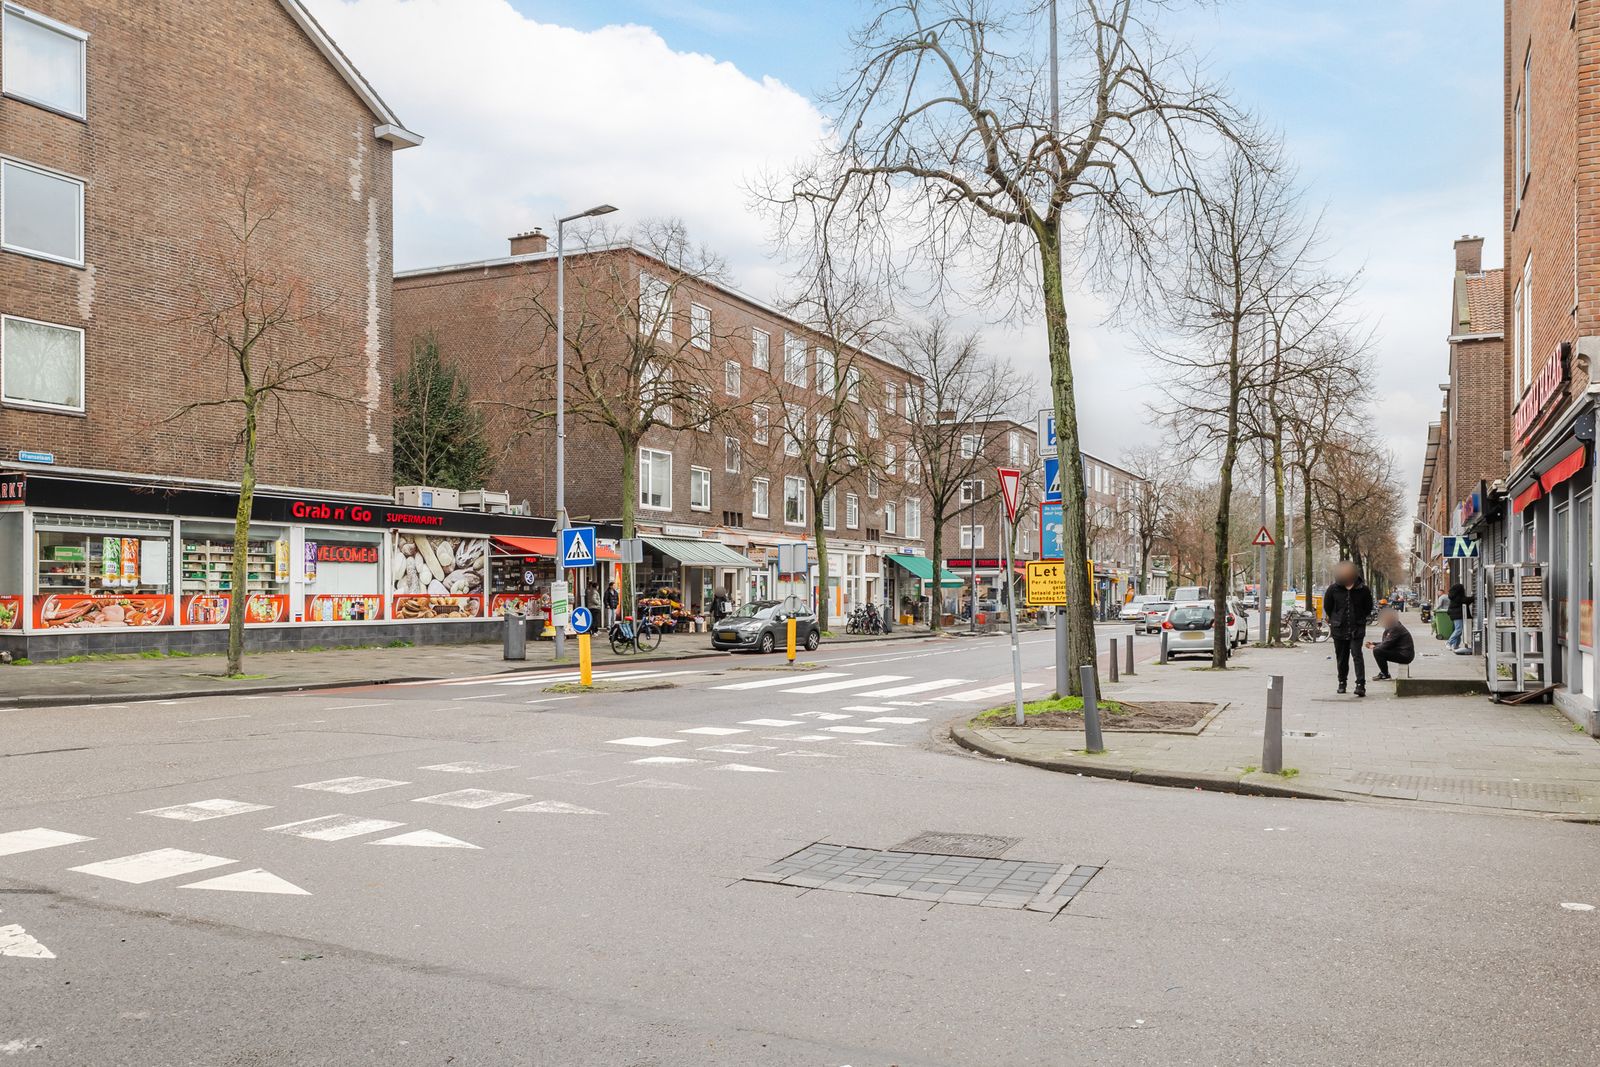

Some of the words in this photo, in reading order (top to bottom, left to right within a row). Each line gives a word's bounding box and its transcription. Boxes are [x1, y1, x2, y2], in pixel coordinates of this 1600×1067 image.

[0, 482, 23, 498] RKT
[292, 501, 331, 519] Grab
[351, 506, 372, 522] Go
[387, 513, 444, 525] SUPERMARKT
[1034, 566, 1057, 577] Let
